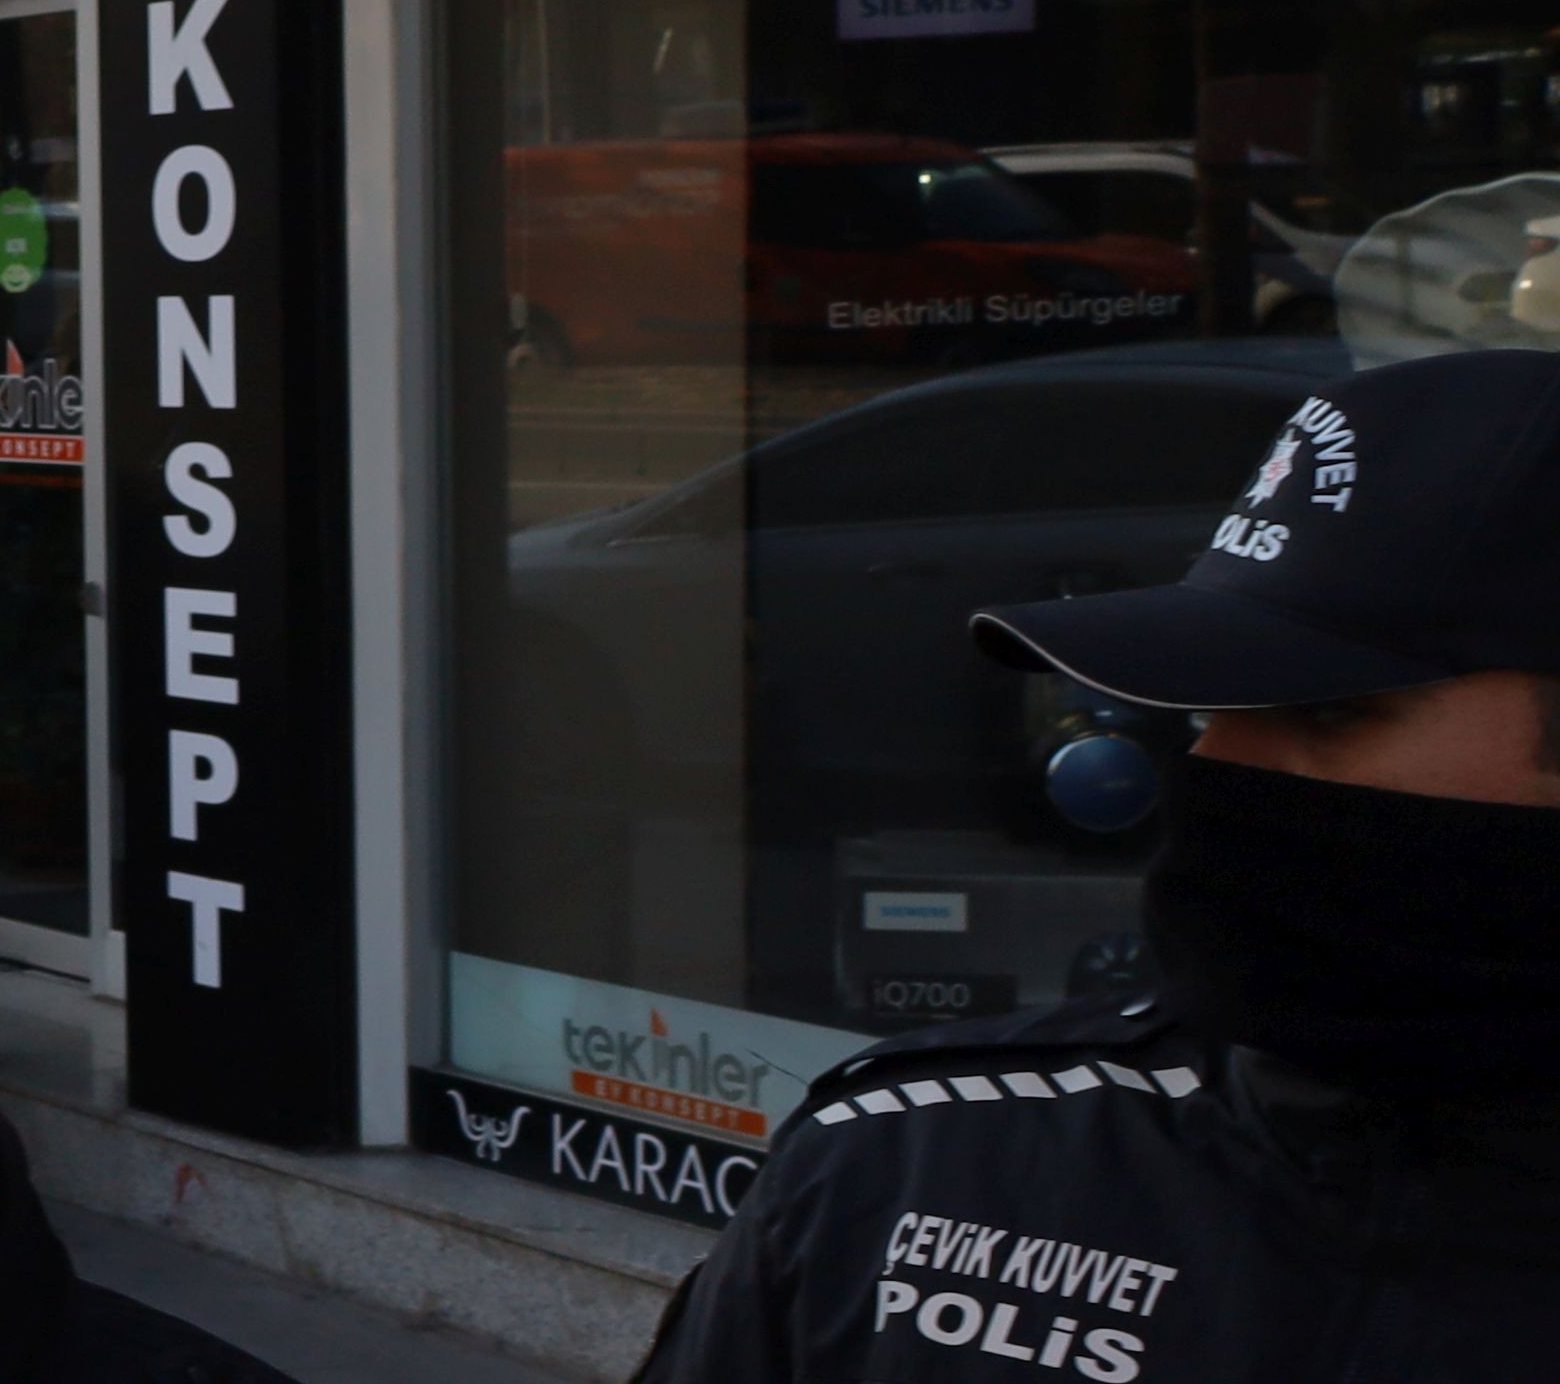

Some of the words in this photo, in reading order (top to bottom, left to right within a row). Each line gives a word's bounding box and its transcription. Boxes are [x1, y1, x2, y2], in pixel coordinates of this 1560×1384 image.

[826, 295, 975, 330] Elektrikli
[983, 287, 1184, 326] Süpürgeler
[1210, 513, 1291, 562] OLİS
[562, 1007, 769, 1107] tekinler
[881, 1211, 1010, 1279] ÇEVİK
[998, 1235, 1179, 1318] KUVVET
